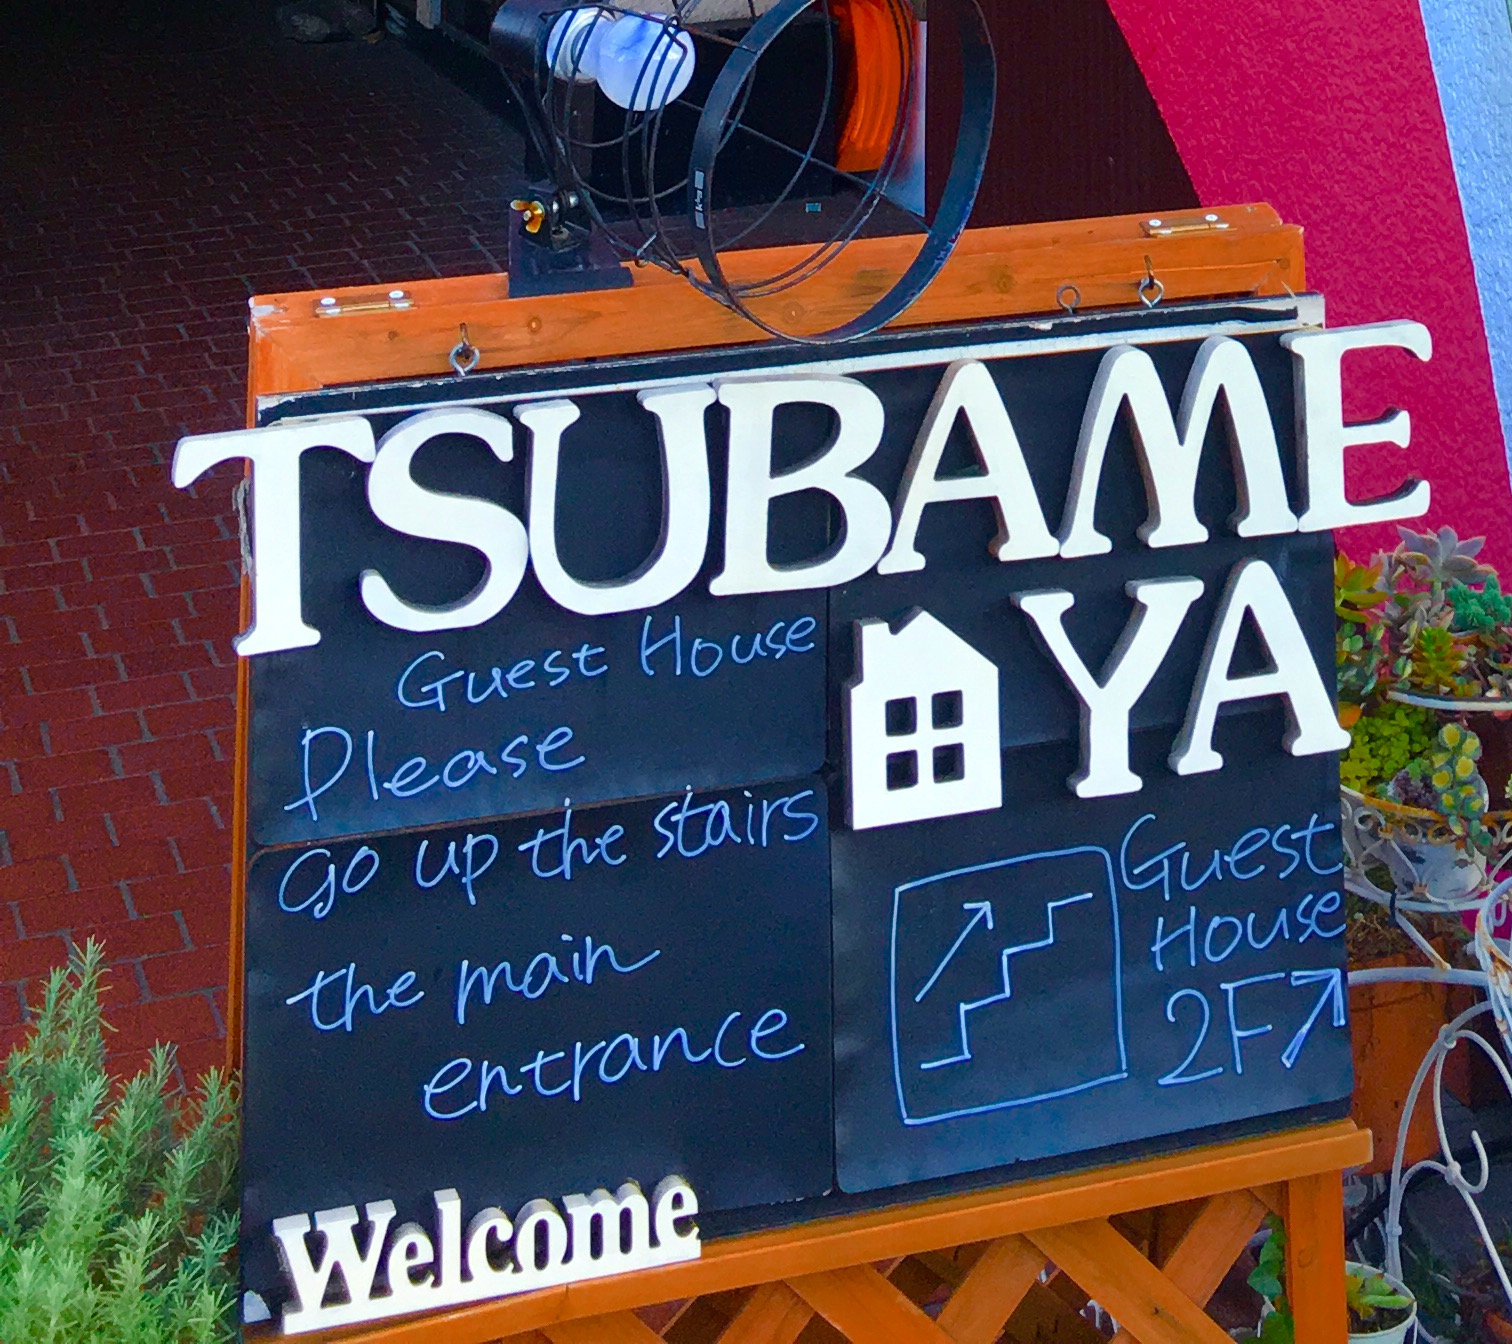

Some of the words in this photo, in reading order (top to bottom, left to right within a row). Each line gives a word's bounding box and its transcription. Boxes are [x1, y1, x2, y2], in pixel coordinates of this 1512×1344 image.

[170, 319, 1433, 657] TSUBAME
[397, 641, 609, 712] Guest
[640, 614, 817, 678] House
[1010, 558, 1352, 798] YA
[283, 724, 586, 821] Please
[414, 832, 500, 906] up
[518, 798, 628, 880] the
[655, 784, 819, 860] stairs
[1120, 813, 1344, 901] Guest
[286, 962, 426, 1032] the
[456, 934, 661, 1024] main
[1150, 889, 1347, 971] House
[423, 1008, 806, 1121] entrance
[1157, 971, 1286, 1087] 2F
[271, 1174, 701, 1334] Welcome
